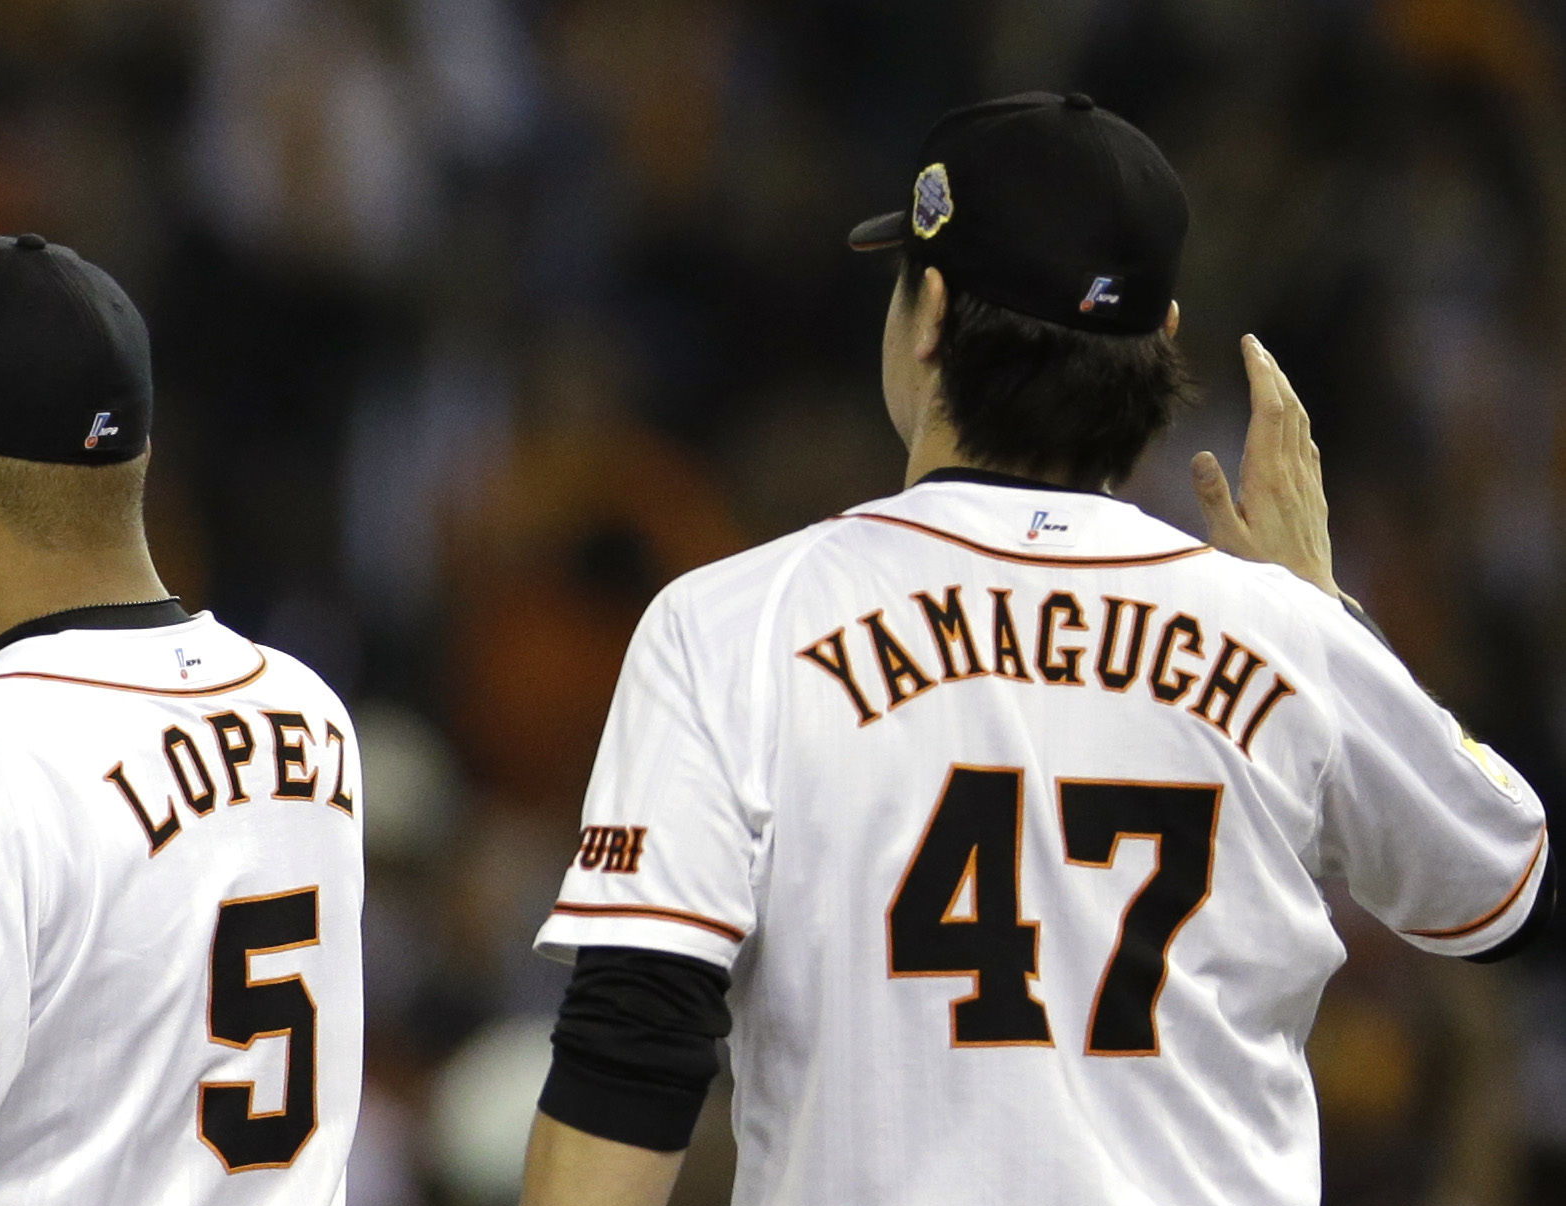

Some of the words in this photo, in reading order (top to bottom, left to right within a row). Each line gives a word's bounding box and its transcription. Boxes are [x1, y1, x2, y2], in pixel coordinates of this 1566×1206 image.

[103, 709, 355, 858] LOPEZ
[796, 584, 1297, 760] YAMAGUCHI
[885, 762, 1225, 1058] 47
[196, 884, 320, 1175] 5
